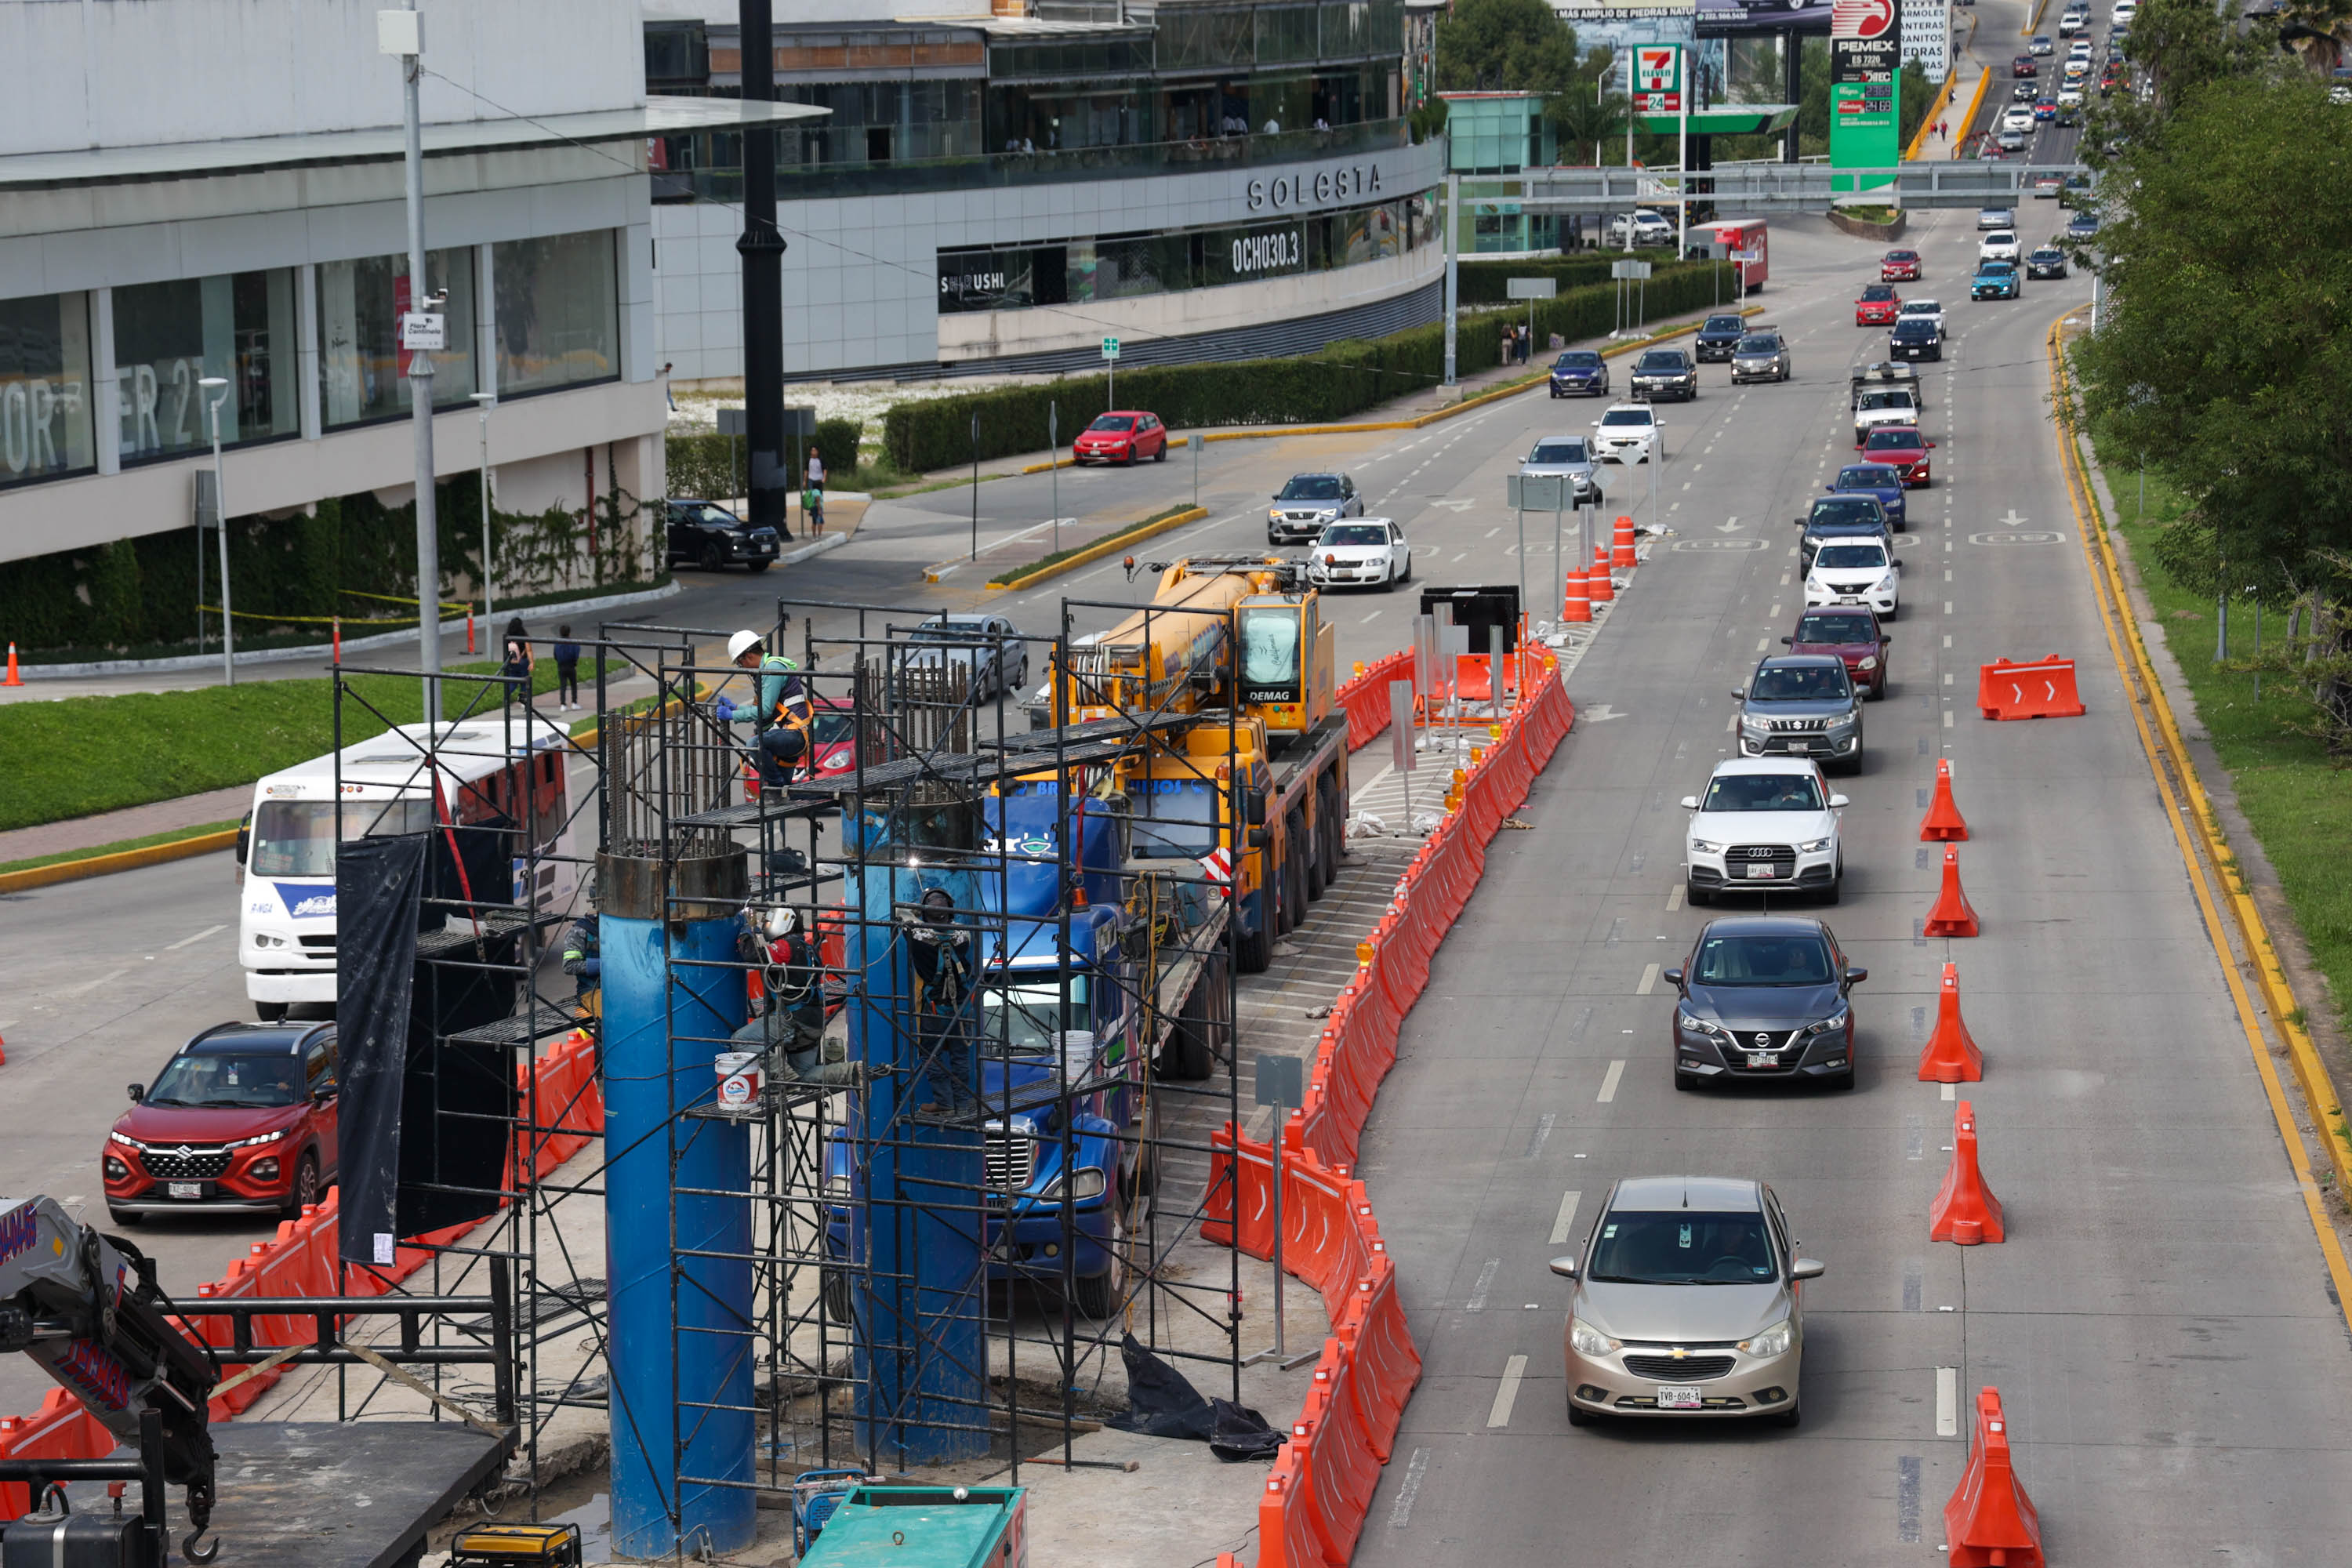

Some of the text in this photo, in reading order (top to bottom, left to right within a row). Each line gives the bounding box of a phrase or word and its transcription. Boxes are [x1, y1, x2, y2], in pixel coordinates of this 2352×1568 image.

[1581, 8, 1613, 19] AMPLIO
[1615, 8, 1628, 18] DE
[1629, 6, 1668, 18] PIEDRAS
[1838, 40, 1894, 53] PEMEX
[1649, 96, 1664, 109] 24
[1232, 230, 1298, 273] OCHO30.3
[1250, 691, 1290, 701] DEMAG
[1660, 1392, 1700, 1401] TVB-604-A
